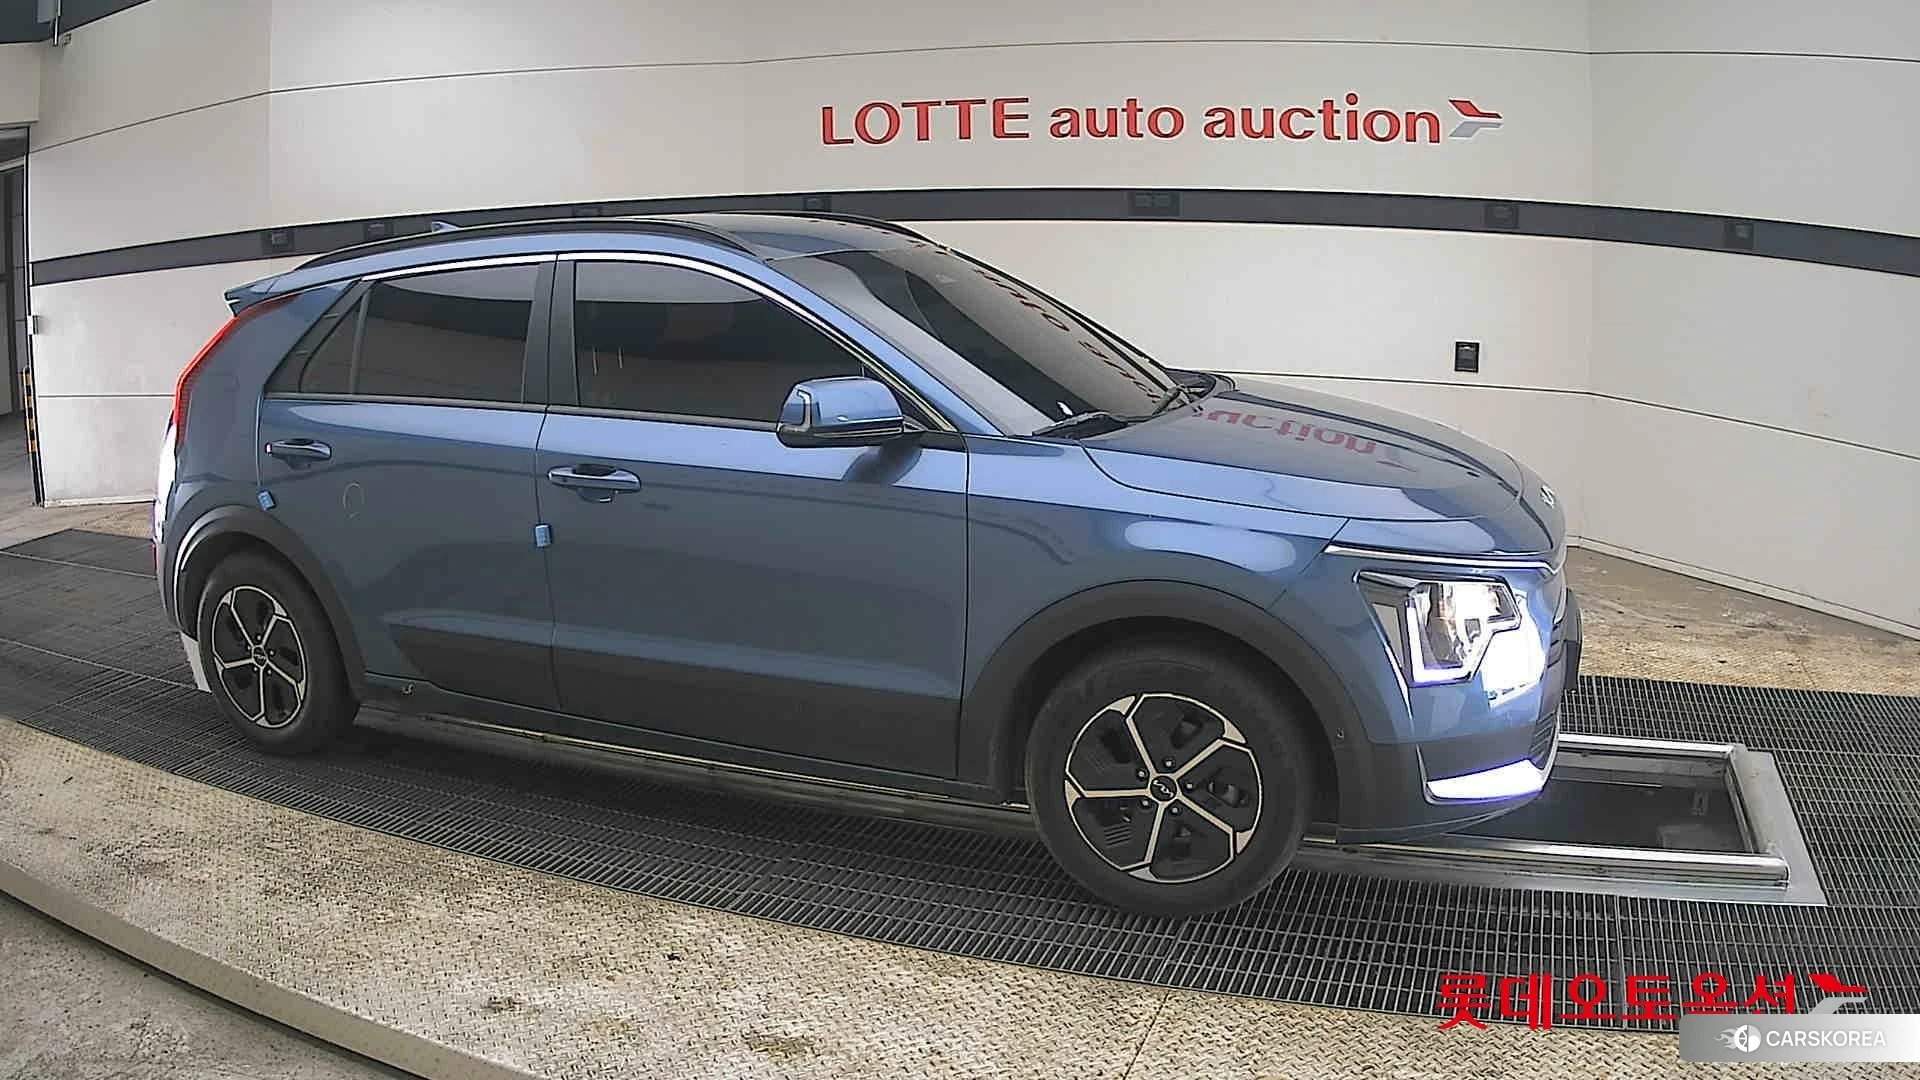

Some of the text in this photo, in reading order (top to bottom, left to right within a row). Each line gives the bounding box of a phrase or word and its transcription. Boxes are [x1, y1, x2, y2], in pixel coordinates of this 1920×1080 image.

[821, 91, 1441, 145] LOTTE auto auction
